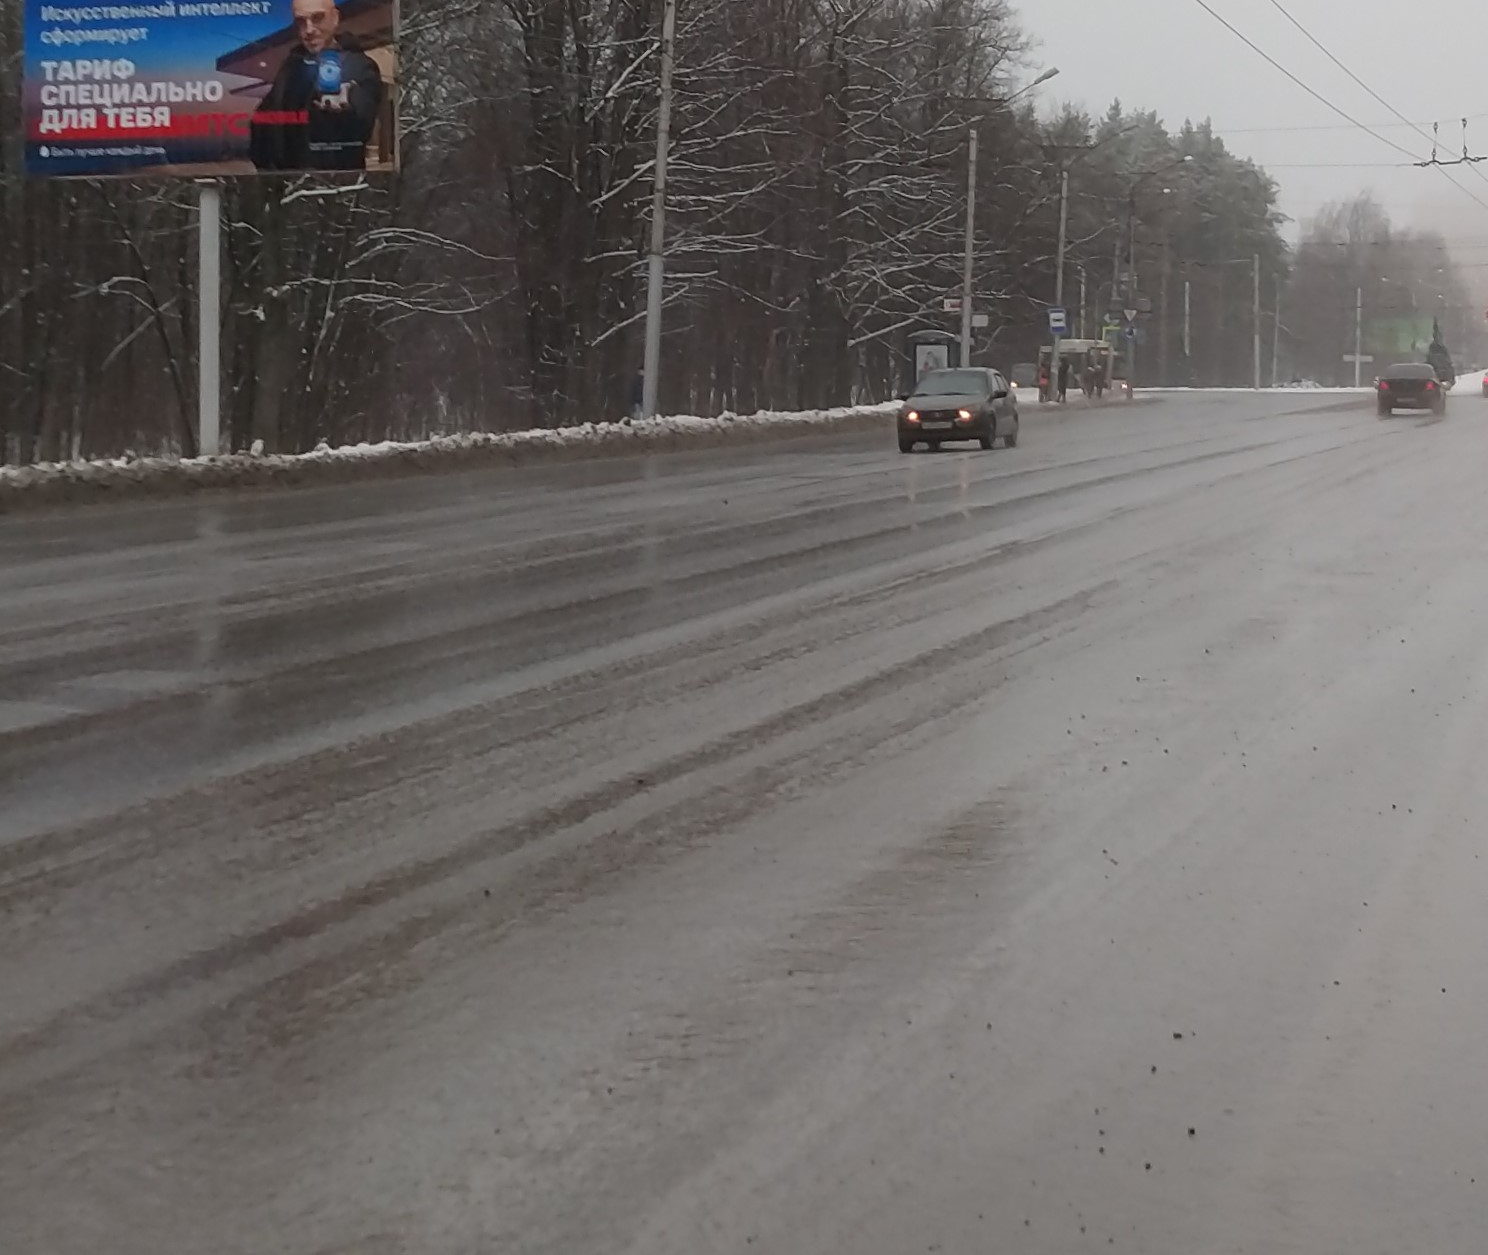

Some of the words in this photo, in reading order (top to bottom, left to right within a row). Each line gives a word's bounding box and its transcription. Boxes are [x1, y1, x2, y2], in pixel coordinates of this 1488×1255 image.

[41, 0, 176, 24] Искусственный
[179, 1, 271, 16] интеллект
[40, 27, 149, 46] сформирует
[40, 58, 135, 81] ТАРИФ
[40, 80, 223, 107] СПЕЦИАЛЬНО
[39, 107, 97, 134] ДЛЯ
[102, 106, 171, 128] ТЕБЯ
